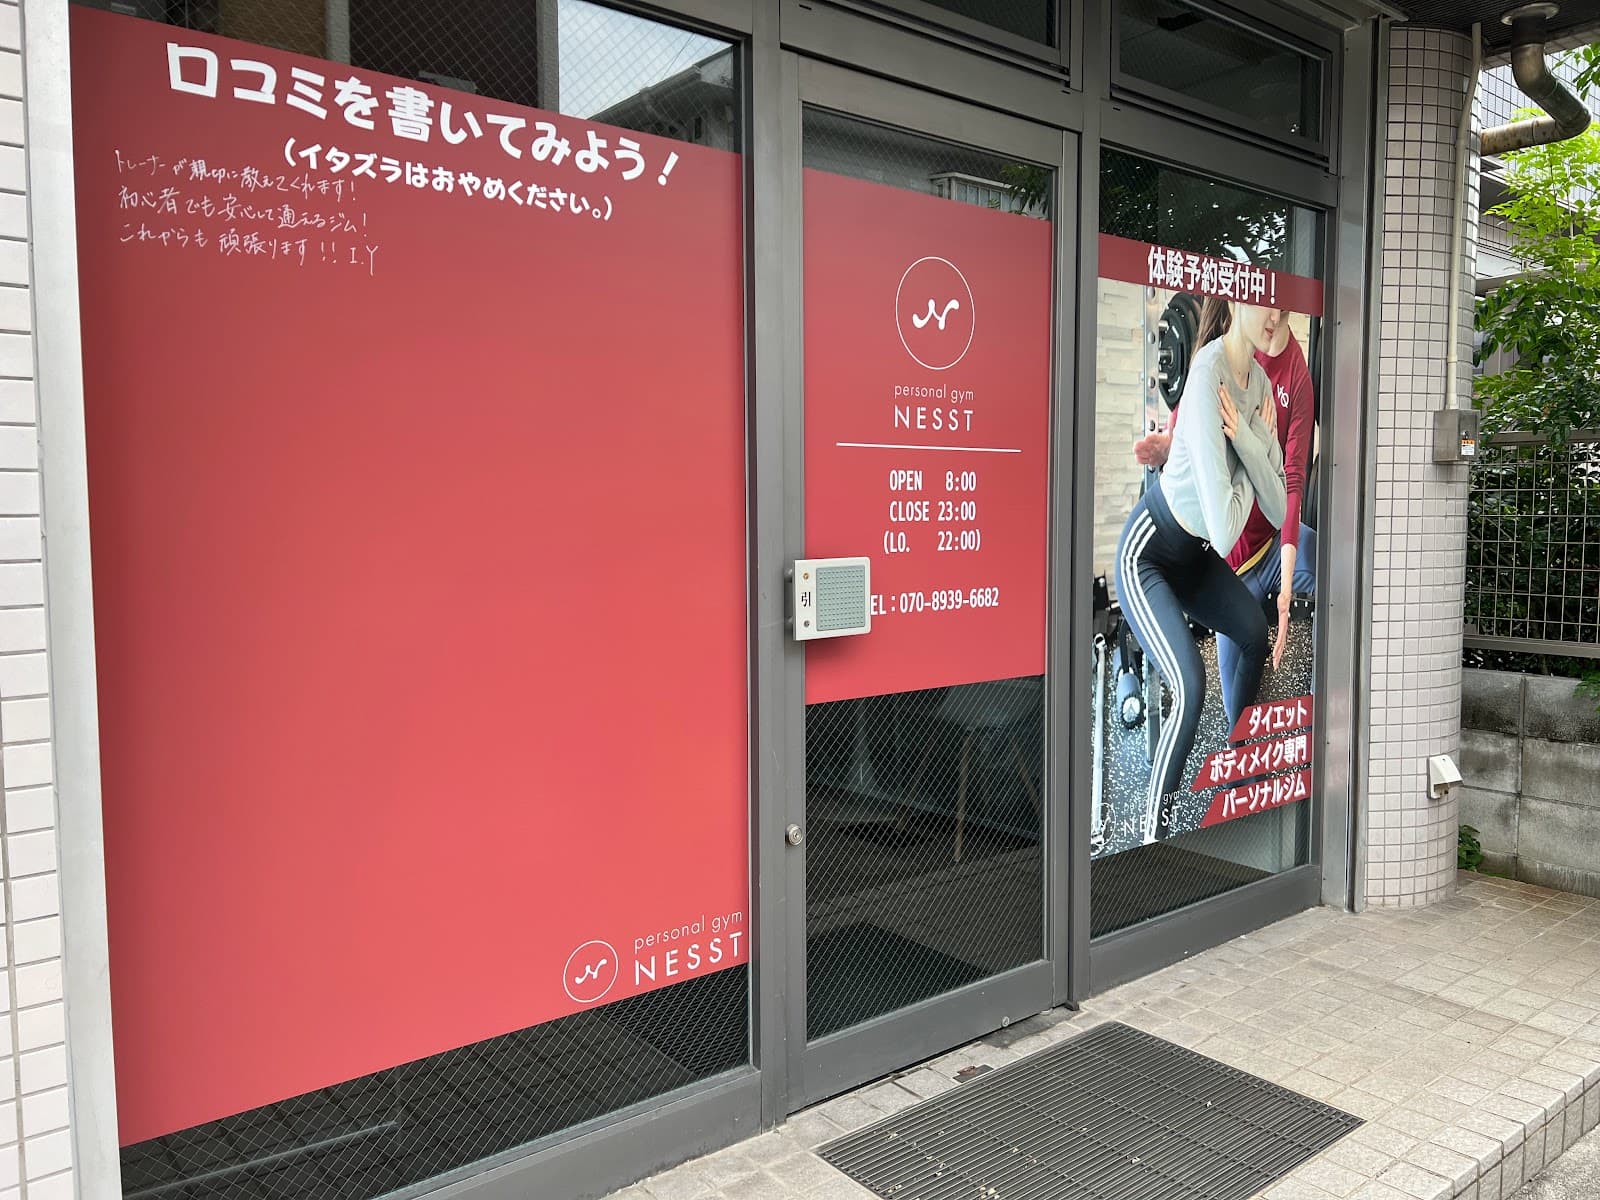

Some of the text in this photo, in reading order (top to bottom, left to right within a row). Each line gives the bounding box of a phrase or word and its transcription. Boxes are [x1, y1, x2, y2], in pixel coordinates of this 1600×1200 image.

[166, 42, 680, 186] 口コミを書いてみよう！
[1147, 245, 1278, 305] 体験予約受付中！
[894, 383, 974, 404] personal gym
[894, 404, 974, 432] NESST
[889, 469, 977, 492] OPEN 8:00
[889, 500, 977, 522] CLOSE 23:00
[883, 528, 981, 554] (LO. 22:00)
[801, 591, 811, 608] 引
[1248, 699, 1308, 736] ダイエット
[1209, 734, 1307, 783] ボディメイク専門
[1221, 773, 1306, 818] パーソナルジム
[1123, 804, 1183, 838] NEST
[634, 911, 743, 955] personal gym
[634, 931, 743, 986] NESST
